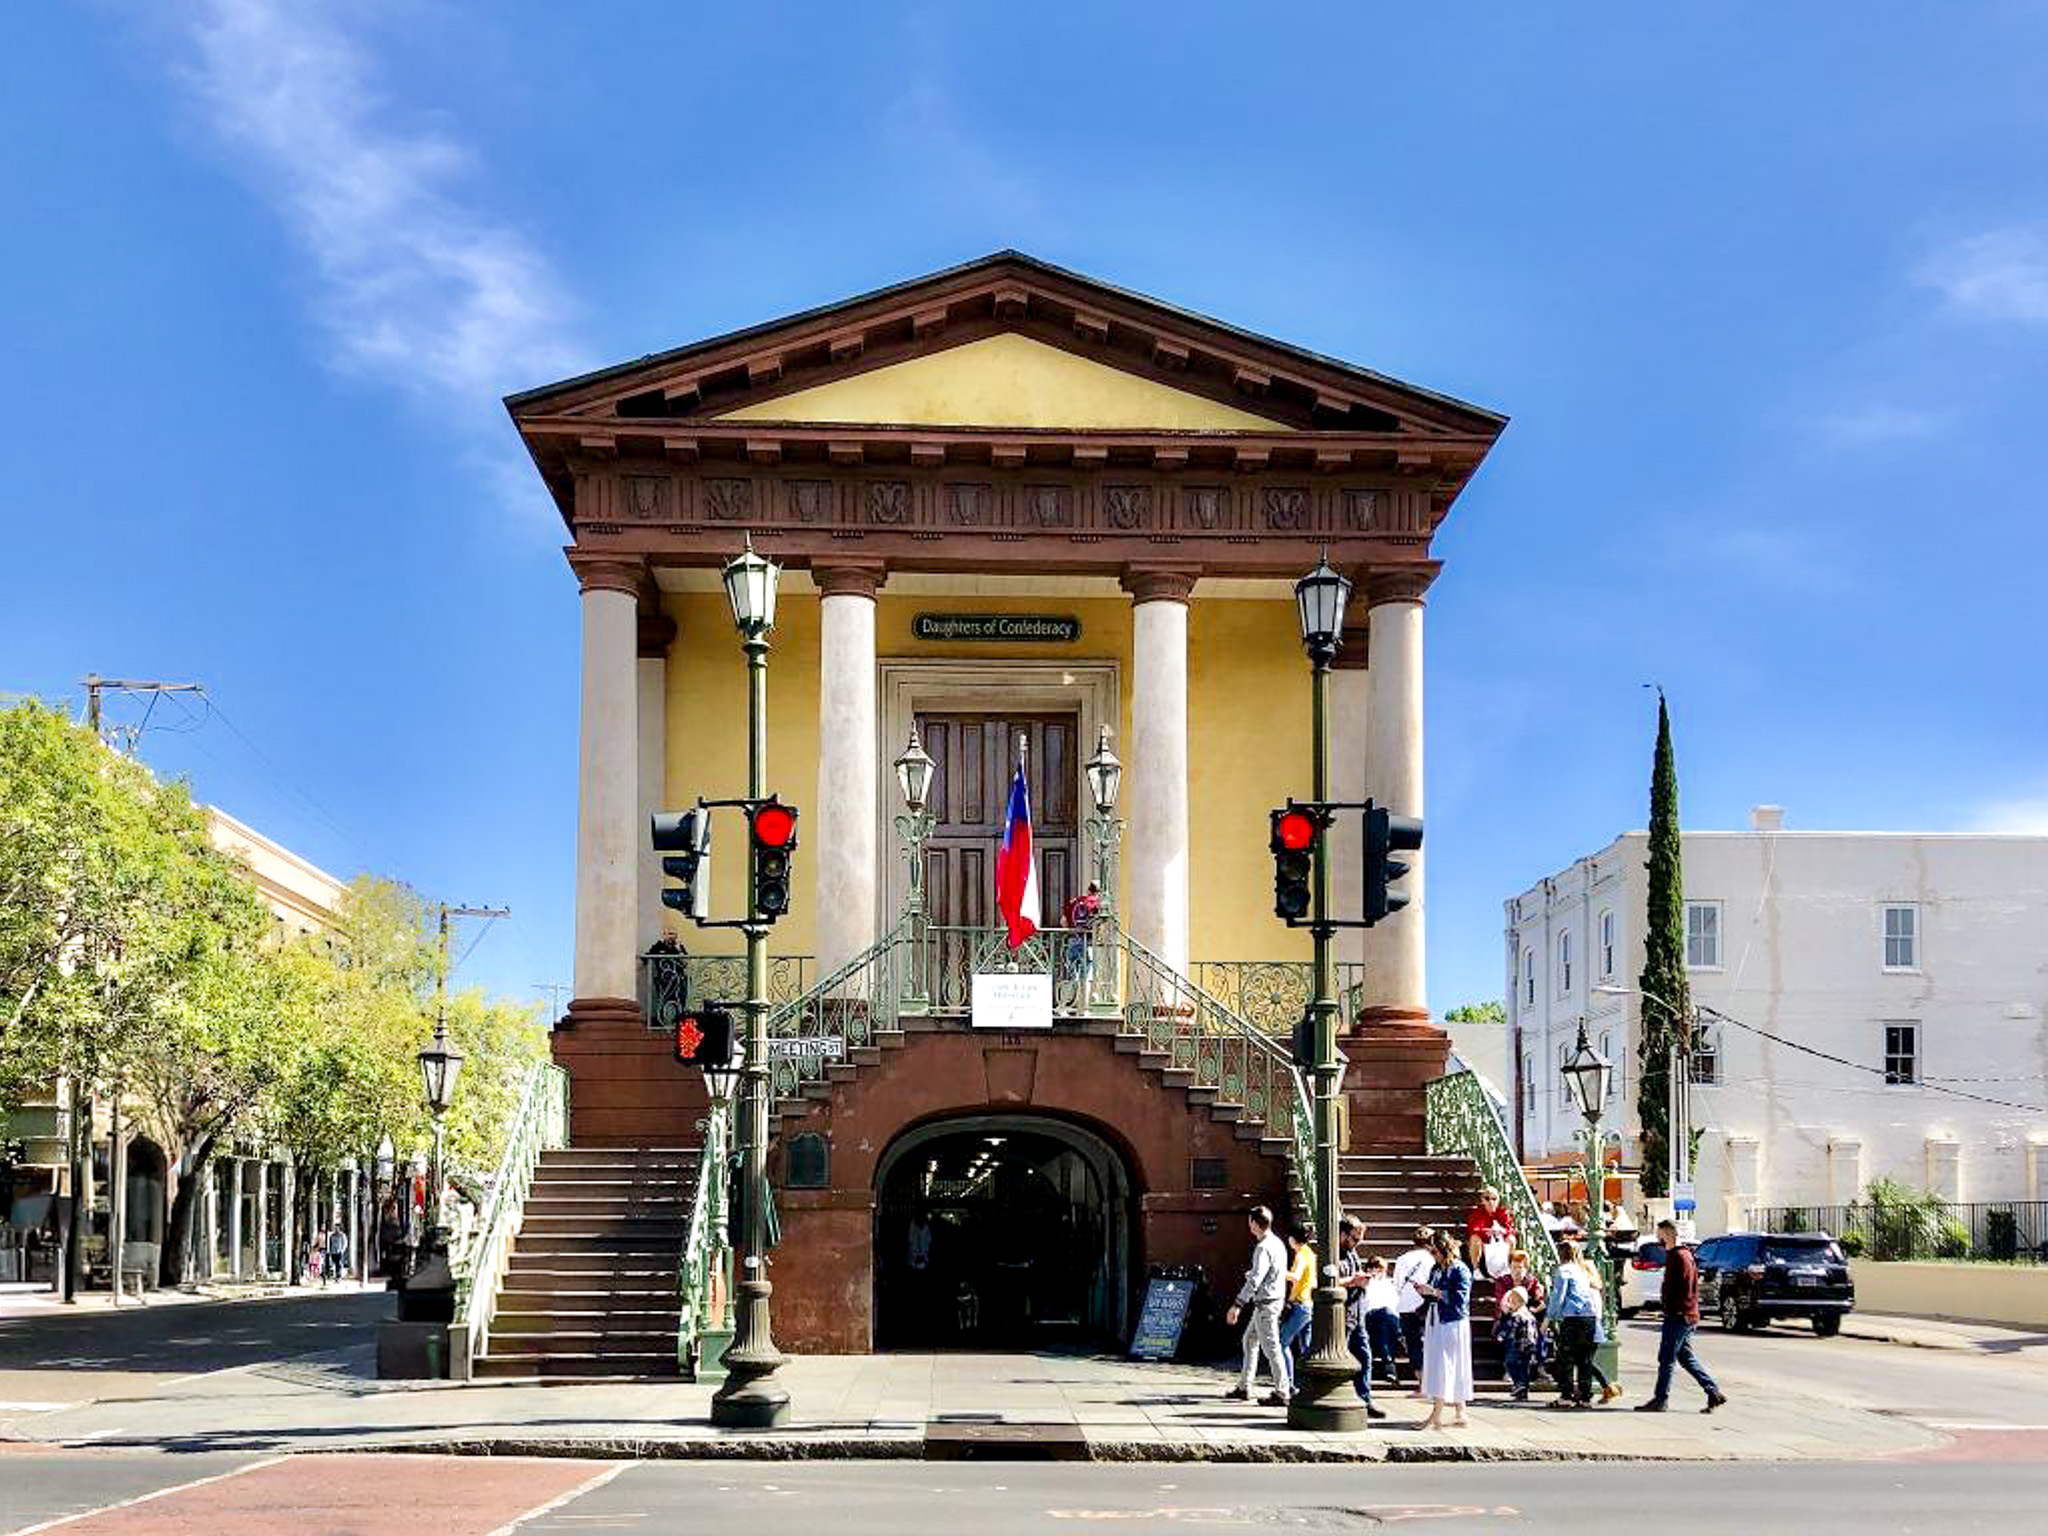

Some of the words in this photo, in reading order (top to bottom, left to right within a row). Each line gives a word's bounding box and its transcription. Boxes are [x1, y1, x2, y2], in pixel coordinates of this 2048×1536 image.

[922, 619, 981, 637] Daughters
[983, 619, 996, 635] of
[998, 619, 1073, 638] Confederacy
[768, 1041, 827, 1056] MEETING
